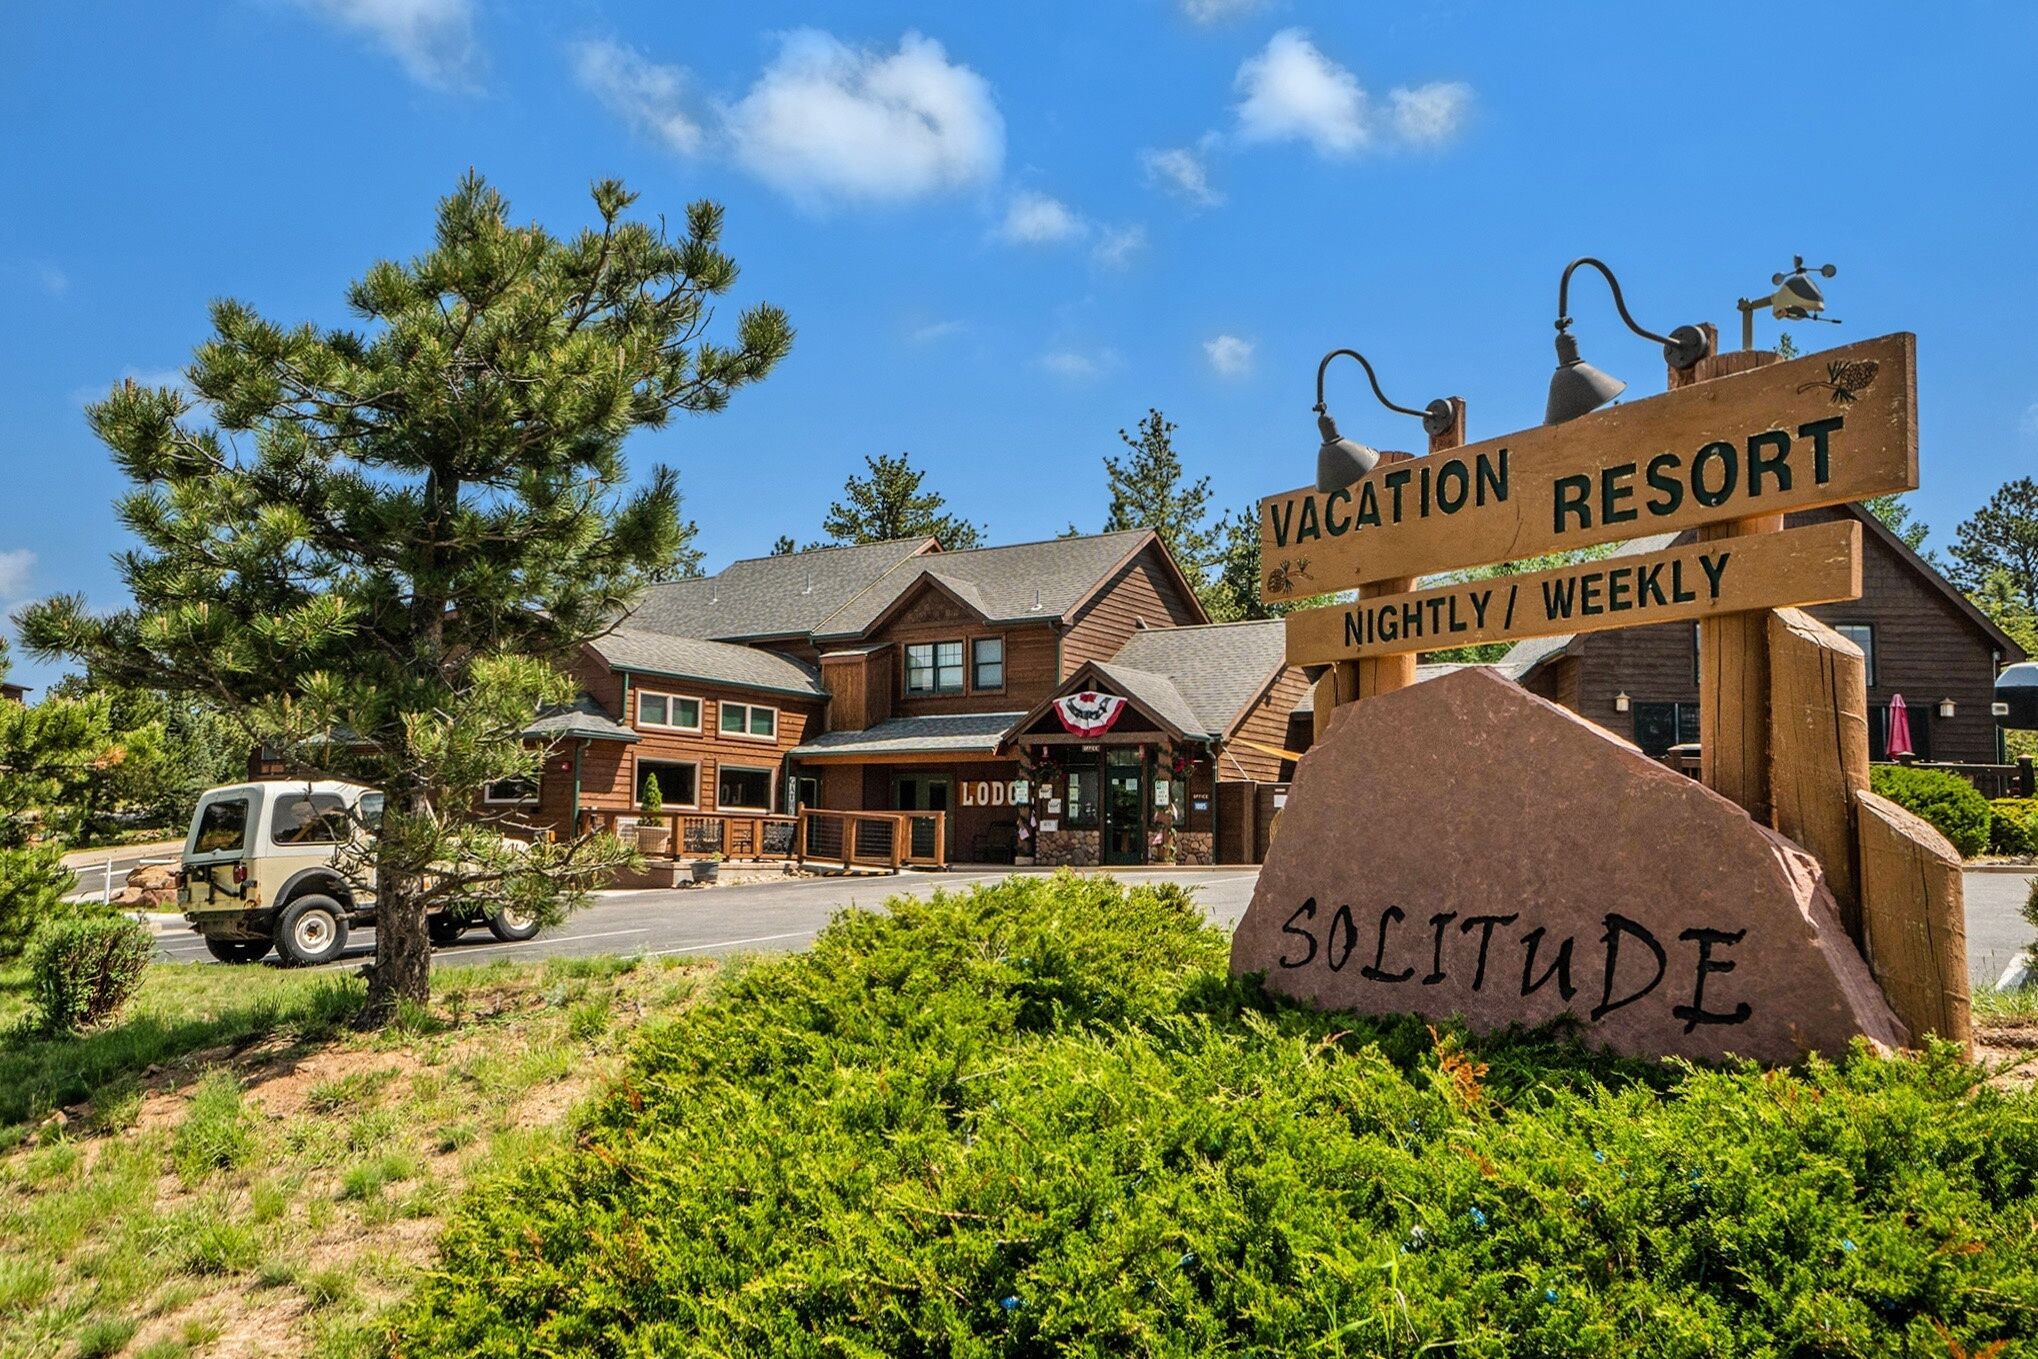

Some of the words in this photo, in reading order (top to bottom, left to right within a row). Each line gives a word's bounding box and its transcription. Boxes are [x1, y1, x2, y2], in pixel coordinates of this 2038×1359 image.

[1271, 448, 1509, 547] VACATION
[1554, 415, 1844, 534] RESORT
[1344, 590, 1492, 648] NIGHTLY
[1542, 552, 1731, 621] WEEKLY
[1279, 897, 1752, 1034] SOLITUDE
